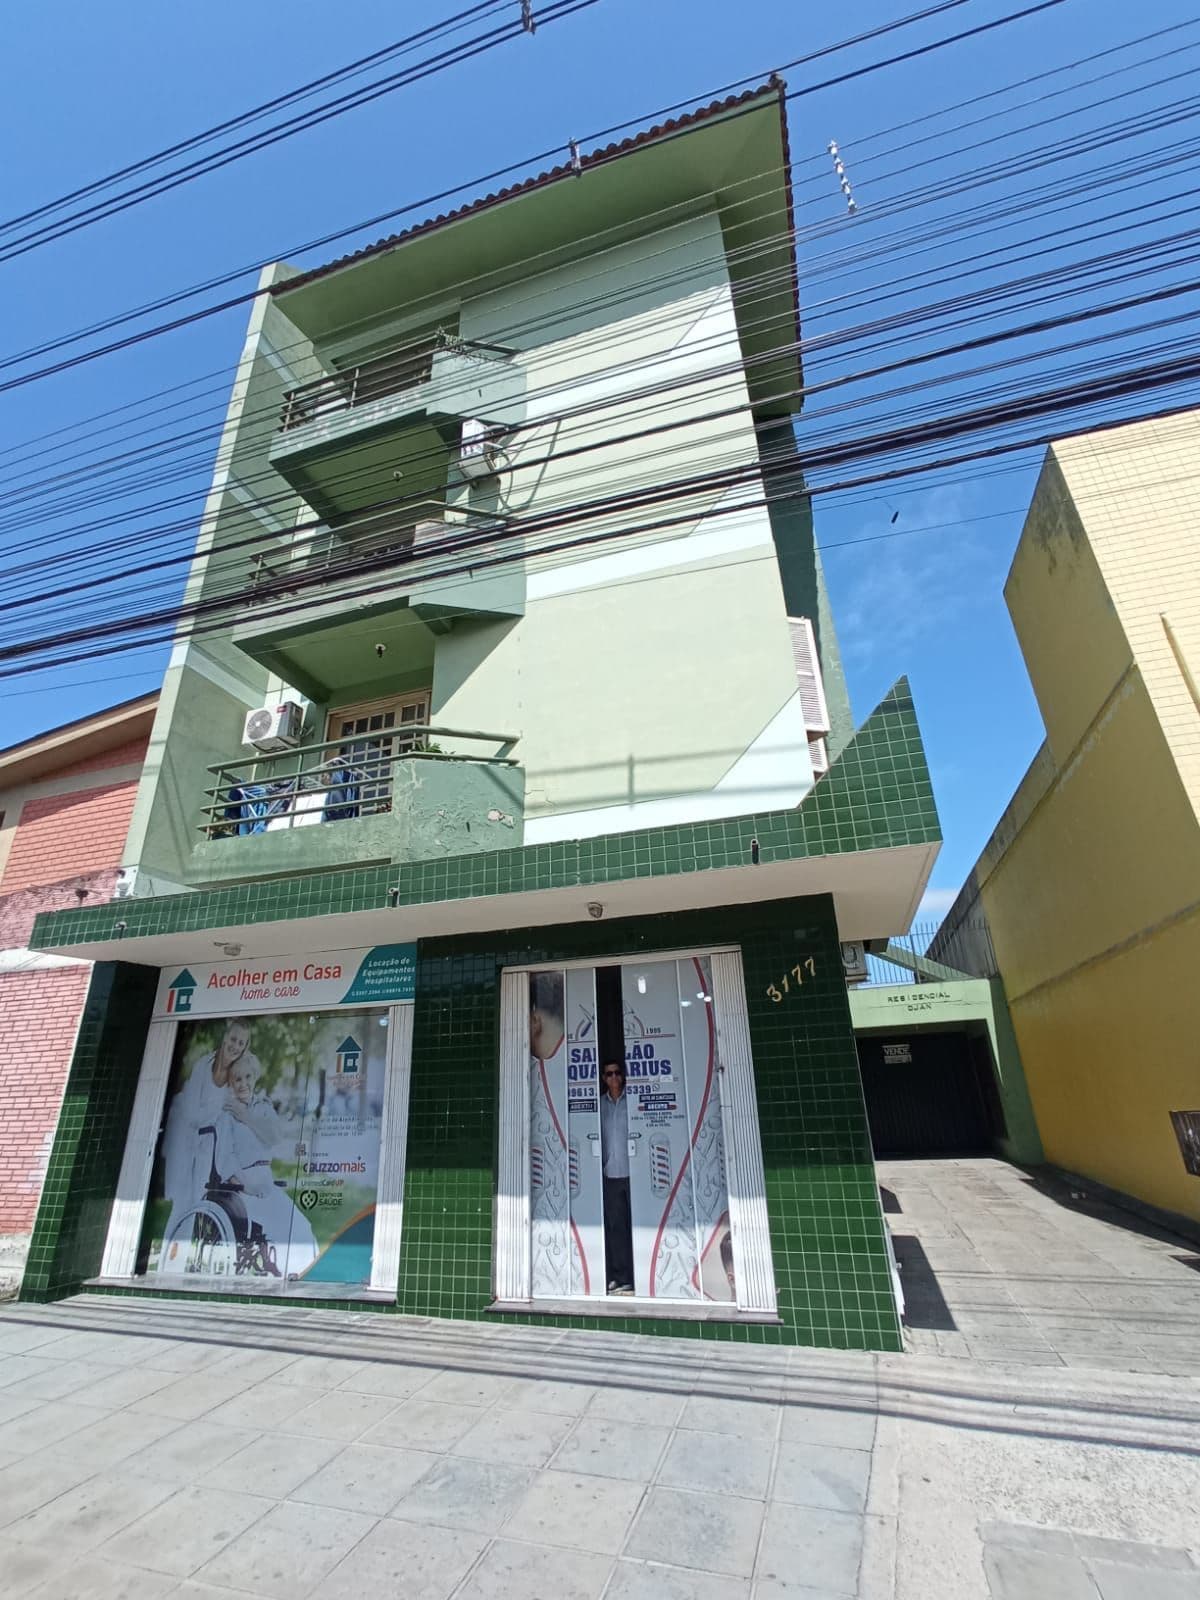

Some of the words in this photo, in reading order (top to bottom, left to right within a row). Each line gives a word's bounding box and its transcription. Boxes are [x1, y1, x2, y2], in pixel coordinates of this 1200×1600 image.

[401, 957, 410, 965] de
[207, 969, 268, 989] Acolher
[272, 969, 298, 982] em
[303, 964, 341, 980] Casa
[767, 956, 816, 1002] 3177
[240, 986, 271, 1000] home
[274, 985, 300, 997] care
